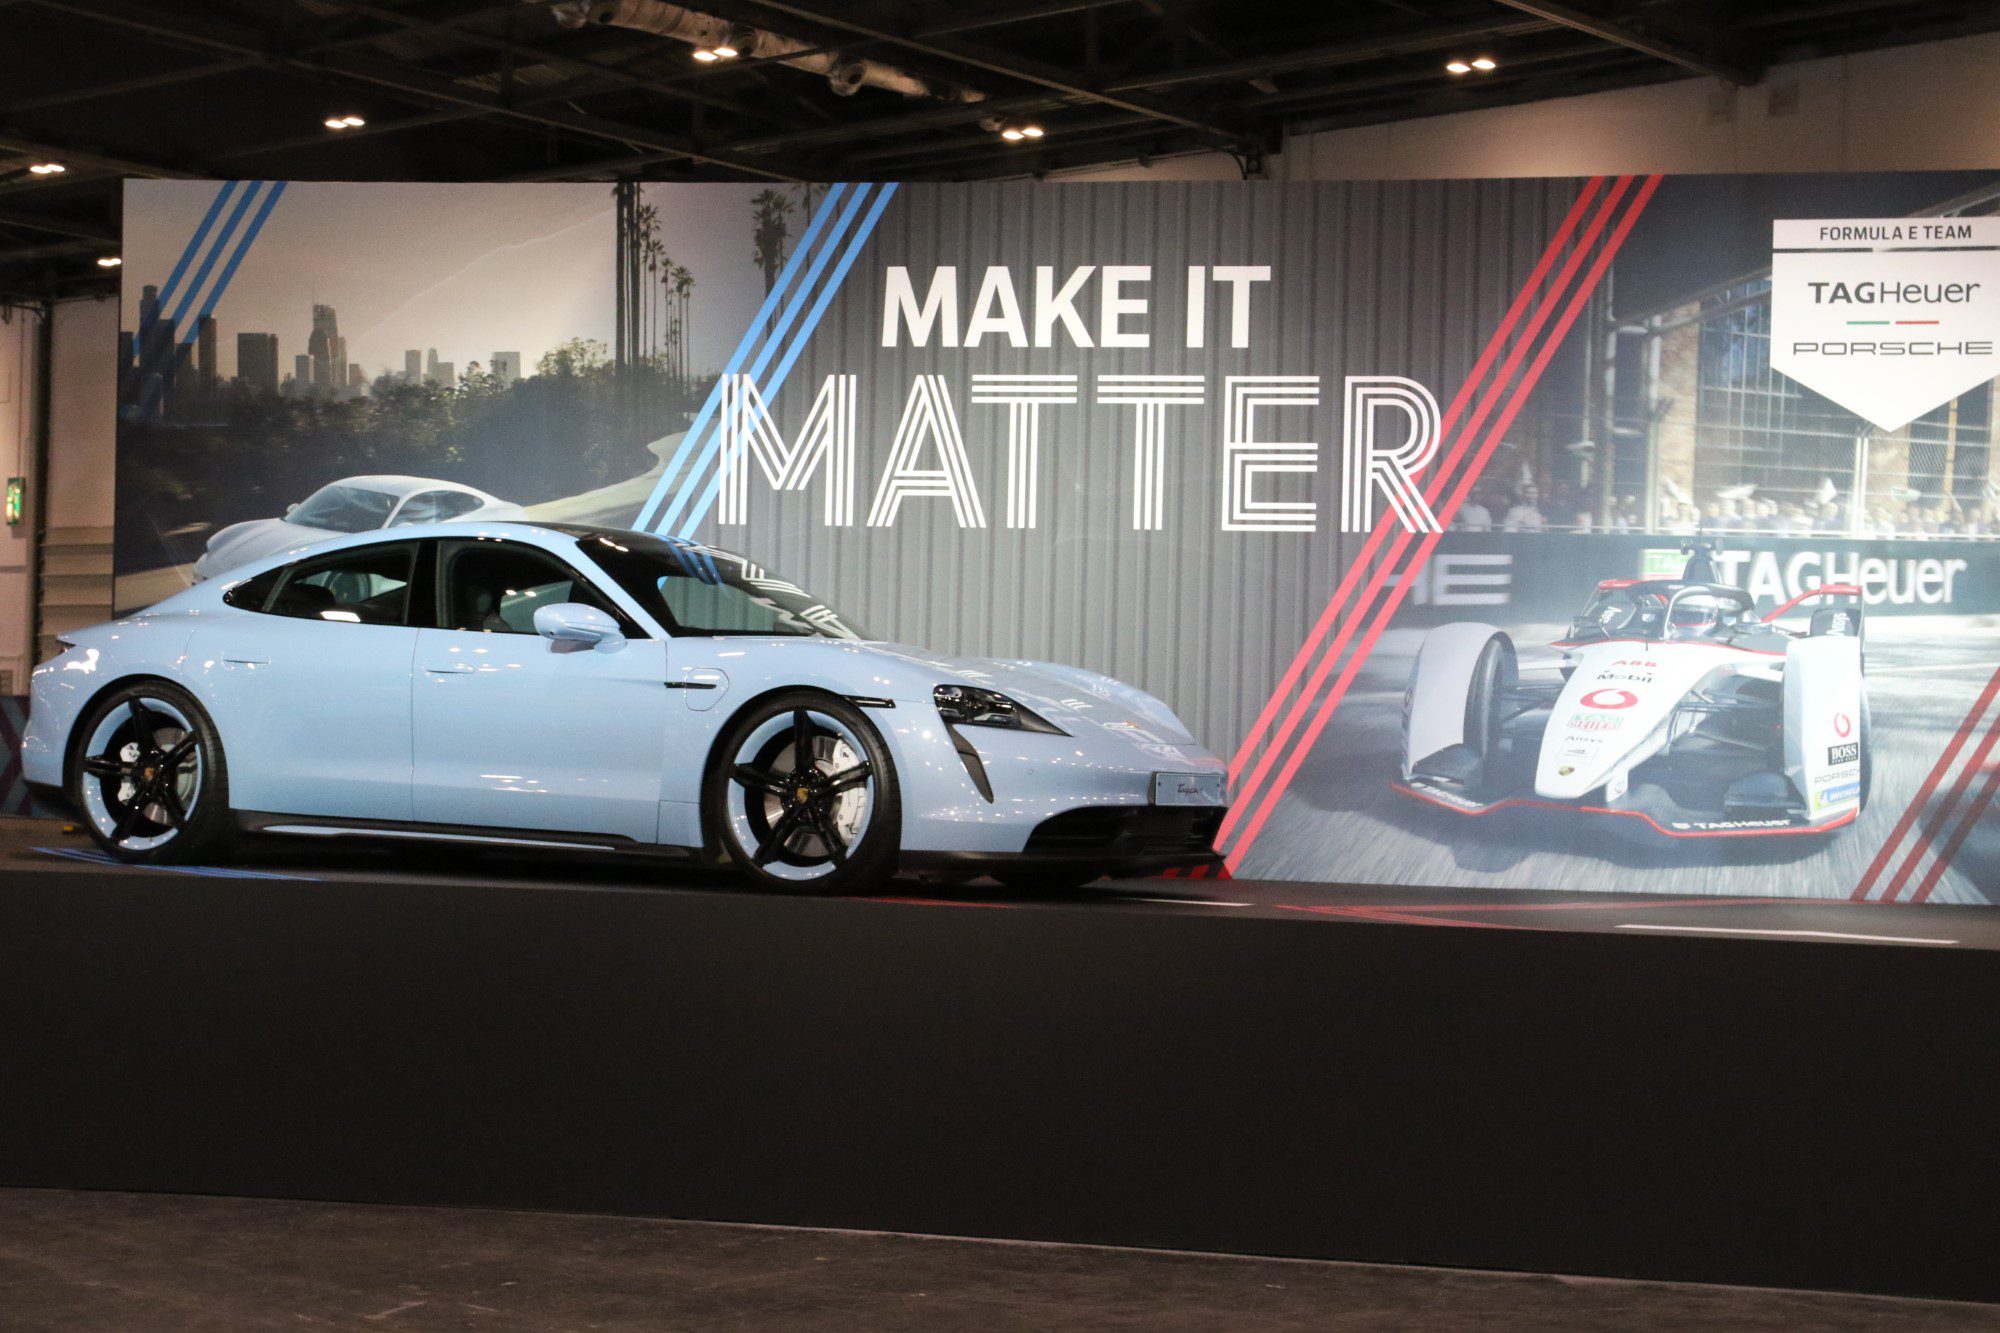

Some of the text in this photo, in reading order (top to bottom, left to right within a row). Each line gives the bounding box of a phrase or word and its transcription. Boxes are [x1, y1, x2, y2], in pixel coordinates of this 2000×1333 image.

[1819, 224, 1973, 241] FORMULA E TEAM
[881, 265, 1272, 349] MAKE IT
[1793, 340, 1993, 356] PORSCHE
[717, 372, 1445, 533] MATTER
[1831, 743, 1857, 760] BOSS
